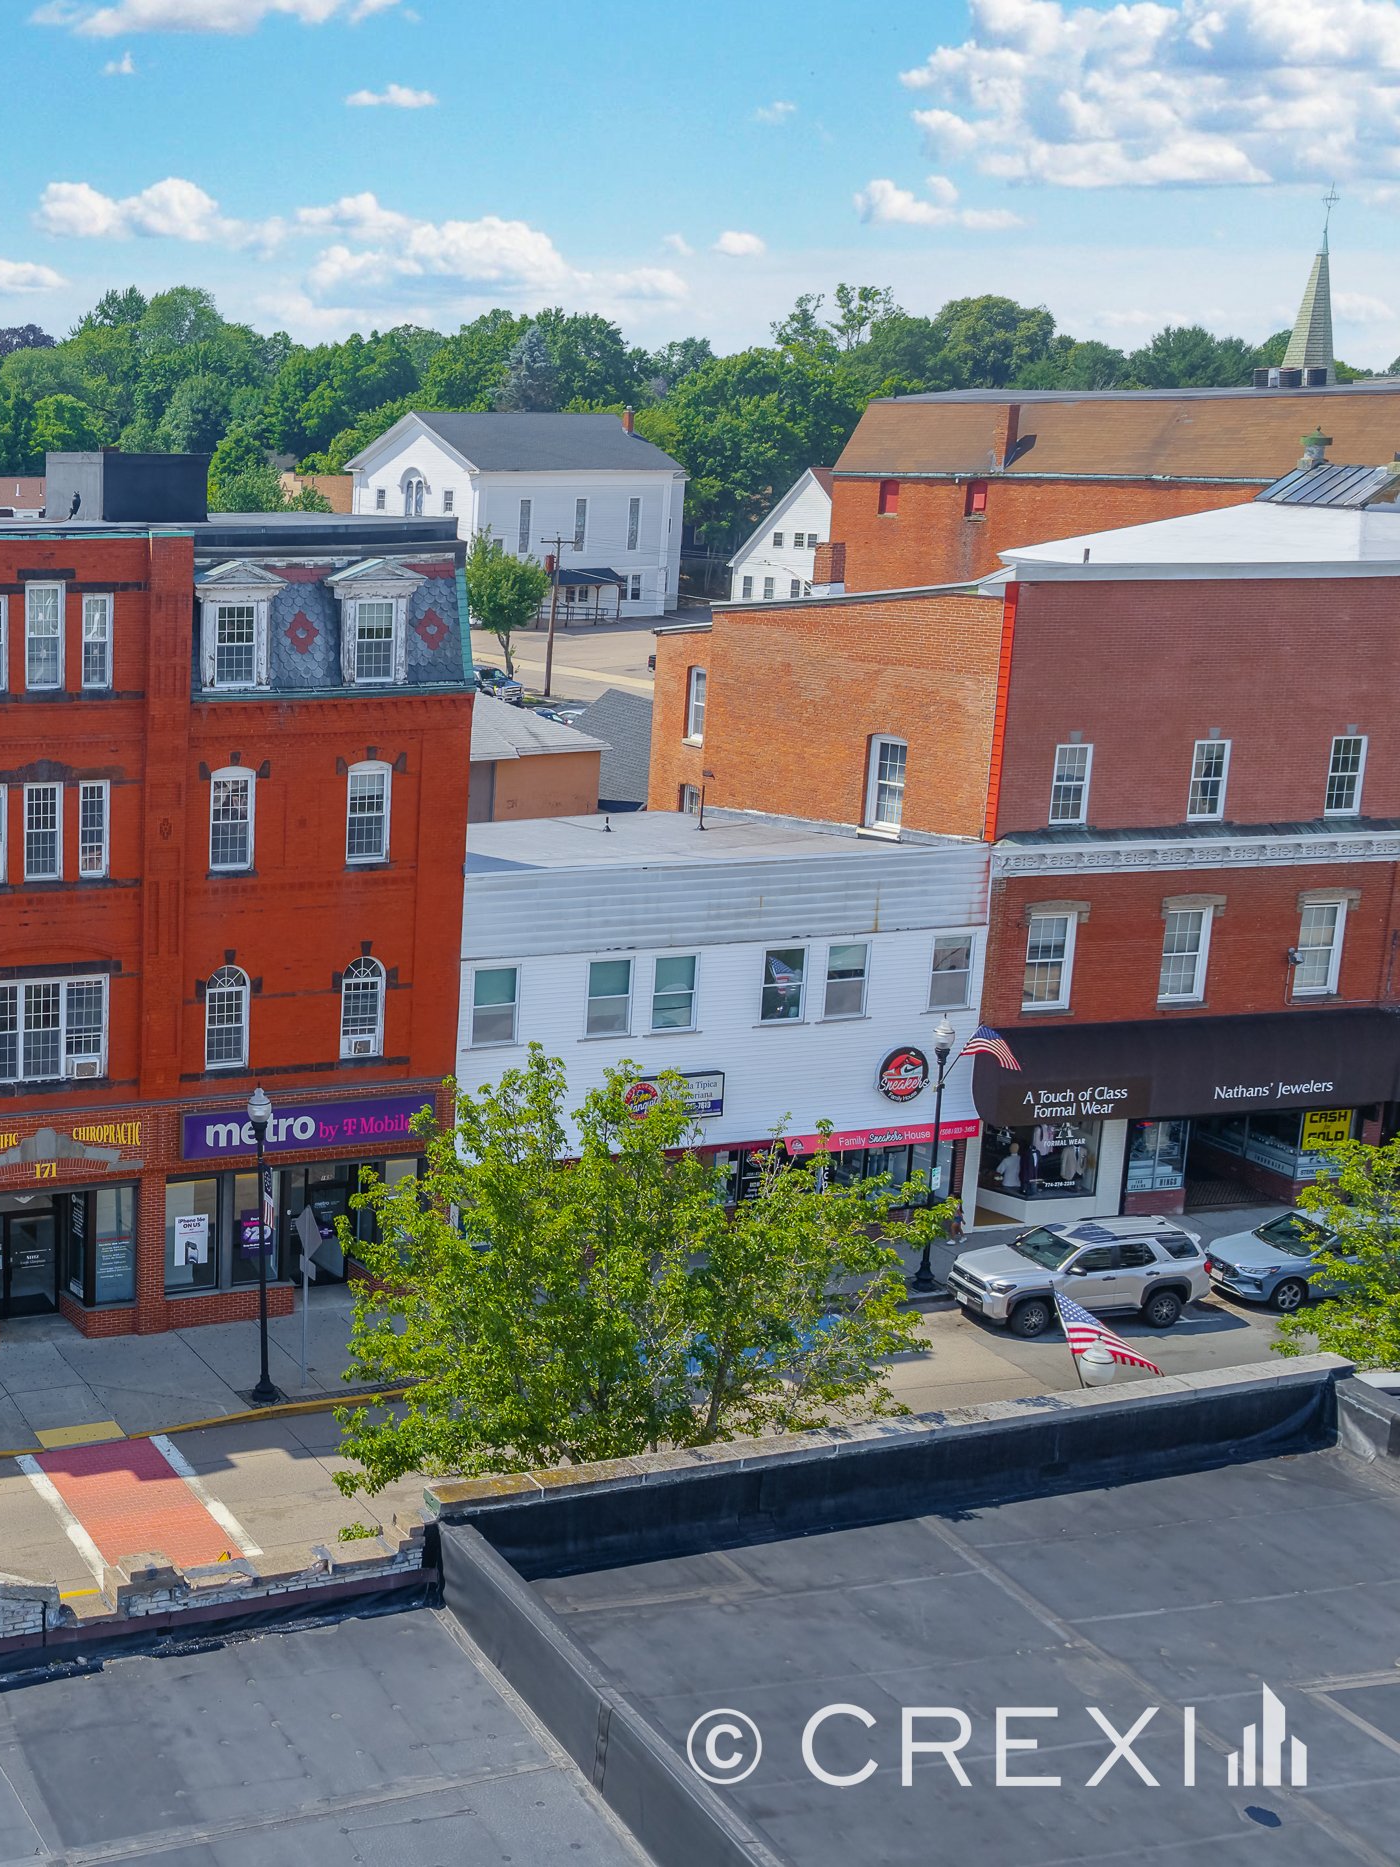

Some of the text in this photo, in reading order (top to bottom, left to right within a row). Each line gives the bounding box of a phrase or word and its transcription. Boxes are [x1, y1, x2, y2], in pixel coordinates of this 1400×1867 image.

[879, 1075, 930, 1092] Sneakers
[1214, 1080, 1334, 1100] Nathans' Jewelers
[888, 1092, 903, 1103] Family
[1023, 1086, 1128, 1104] A Touch of Class
[1034, 1101, 1114, 1118] Formal Wear
[1309, 1111, 1348, 1124] CASH
[72, 1121, 142, 1146] CHIROPRACTIC
[205, 1112, 316, 1148] metro
[319, 1120, 339, 1142] by
[838, 1130, 931, 1148] Family Sneakers House
[1044, 1138, 1086, 1147] FORMAL WEAR
[34, 1163, 57, 1179] 171
